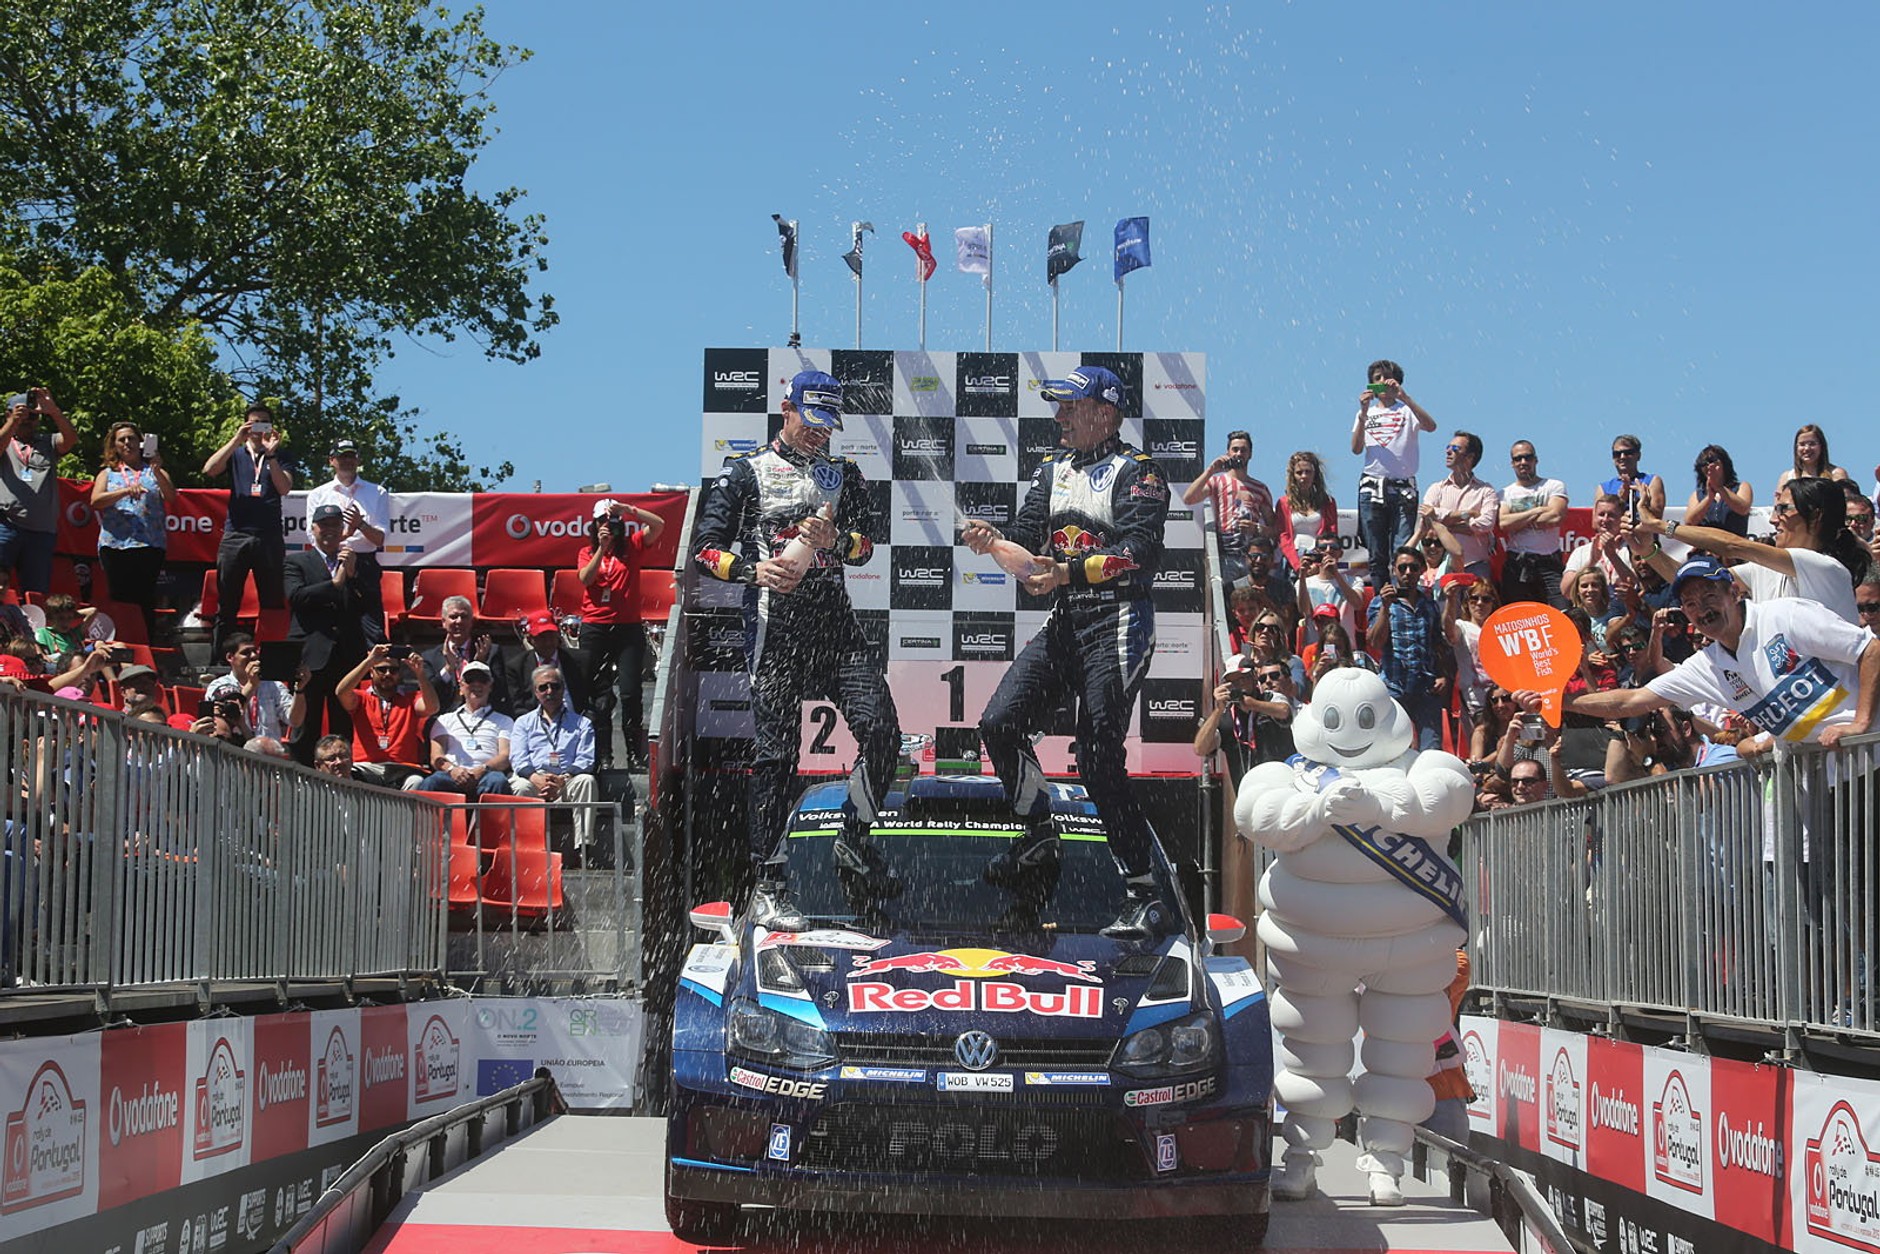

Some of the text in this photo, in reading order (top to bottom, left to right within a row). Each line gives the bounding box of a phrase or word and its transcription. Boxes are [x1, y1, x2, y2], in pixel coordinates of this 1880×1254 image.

[714, 371, 760, 382] WRC
[965, 375, 1010, 386] WRC
[1152, 441, 1197, 452] WRC
[963, 504, 1008, 515] WRC
[899, 568, 944, 579] WRC
[1494, 613, 1550, 634] MATOSINHOS
[961, 633, 1006, 645] WRC
[1530, 647, 1559, 661] World's
[1533, 658, 1552, 669] Best
[1535, 667, 1553, 678] Fish
[941, 666, 964, 722] 1
[1149, 700, 1195, 711] WRC
[809, 705, 838, 754] 2
[870, 821, 1026, 831] A World Rally Champio
[848, 980, 1105, 1019] Red Bull
[476, 1008, 538, 1031] ON.2
[371, 1045, 405, 1084] vodafone
[427, 1059, 457, 1082] Portugal
[540, 1058, 566, 1067] UNIÃO
[866, 1069, 924, 1078] MICHELIN
[267, 1059, 306, 1105] vodafone
[736, 1070, 828, 1100] Castrol EDGE
[946, 1076, 969, 1087] WOB
[1050, 1074, 1108, 1083] MICHELIN
[1506, 1064, 1536, 1104] vodafone
[328, 1079, 351, 1104] Portugal
[1136, 1077, 1216, 1105] Castrol EDGE
[123, 1081, 179, 1137] vodafone
[211, 1102, 242, 1129] Portugal
[1556, 1102, 1578, 1130] Portugal
[1600, 1087, 1638, 1136] vodafone
[29, 1135, 81, 1174] Portugal
[1668, 1136, 1700, 1169] Portugal
[1729, 1119, 1784, 1180] vodafone
[1829, 1179, 1880, 1224] Portugal
